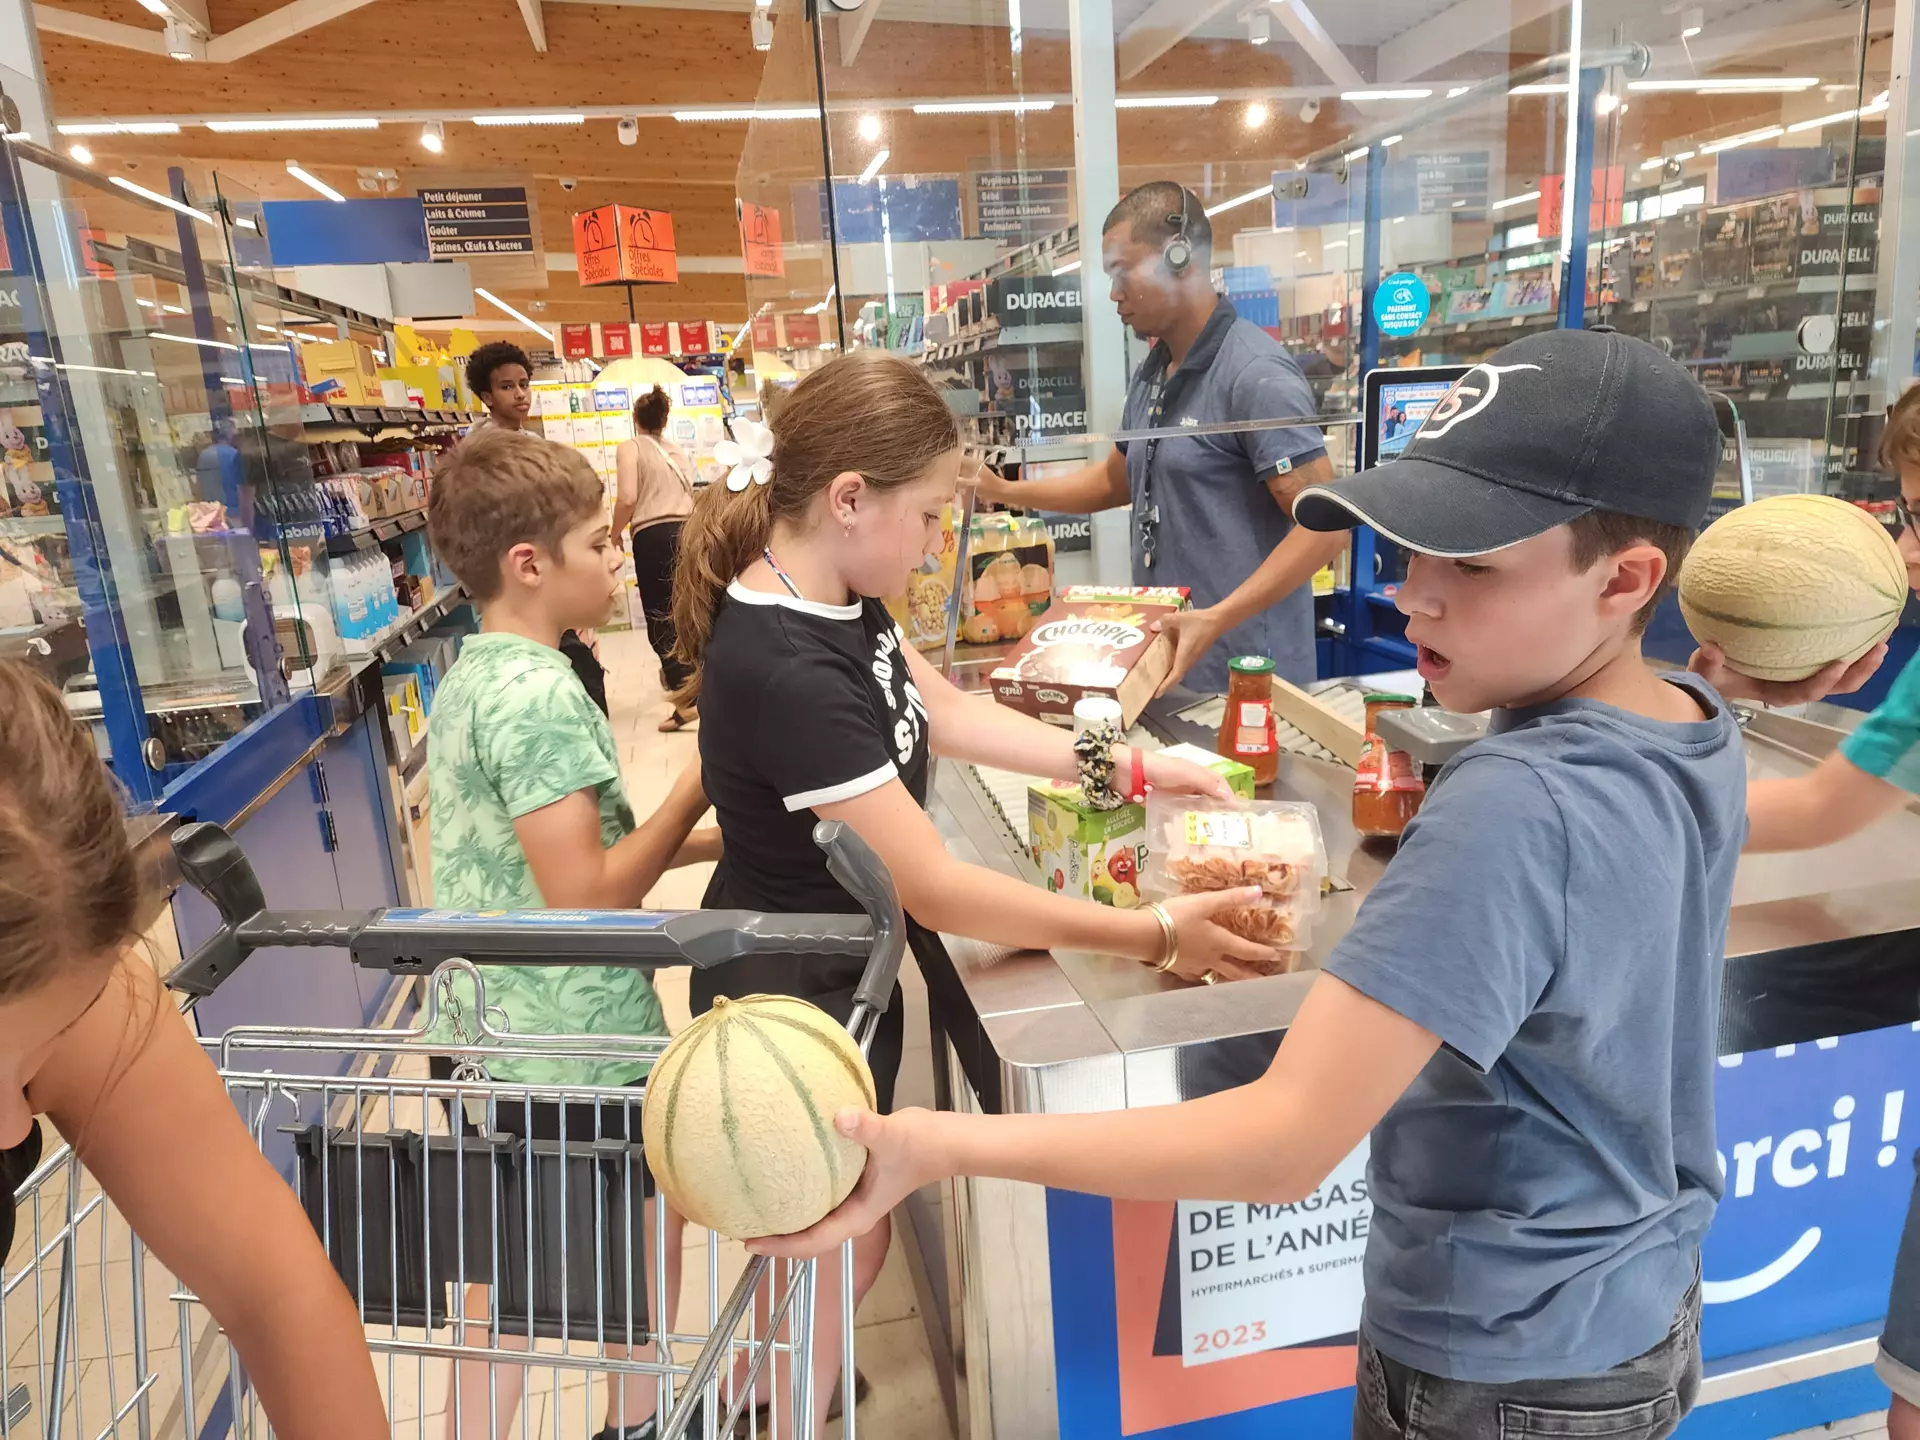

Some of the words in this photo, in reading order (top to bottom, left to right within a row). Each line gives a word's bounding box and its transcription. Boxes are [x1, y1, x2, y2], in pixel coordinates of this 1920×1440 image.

[424, 192, 445, 203] Petit
[446, 191, 482, 203] déjeuner
[425, 208, 446, 219] Laits
[447, 209, 454, 219] &
[455, 207, 486, 219] Crèmes
[983, 206, 1015, 217] Entretien
[1022, 204, 1051, 215] Lessives
[1823, 211, 1875, 226] DURCELL
[429, 225, 458, 237] Goûter
[431, 242, 464, 254] Farines,
[464, 240, 487, 252] Œufs
[487, 241, 495, 251] &
[495, 240, 523, 251] Sucres
[583, 252, 600, 268] Offres
[628, 249, 651, 267] Offres
[1801, 247, 1871, 265] DURAELL
[584, 265, 612, 281] Spéciales
[630, 263, 664, 278] Spéciales
[1387, 304, 1417, 313] PAIEMENT
[1380, 313, 1396, 321] SANS
[1397, 312, 1423, 320] CONTACT
[1018, 376, 1076, 389] DURACELL
[1046, 522, 1091, 541] URAC
[1144, 586, 1180, 597] XXL
[1037, 622, 1137, 646] CHOCAPIC
[1037, 690, 1068, 704] CHOCAPIC
[1103, 826, 1112, 835] EN
[1877, 1089, 1905, 1168] !
[1189, 1204, 1236, 1236] DE
[1190, 1242, 1237, 1274] DE
[1191, 1267, 1294, 1298] HYPERMARCHÉS
[1296, 1267, 1305, 1277] &
[1192, 1320, 1267, 1355] 2023
